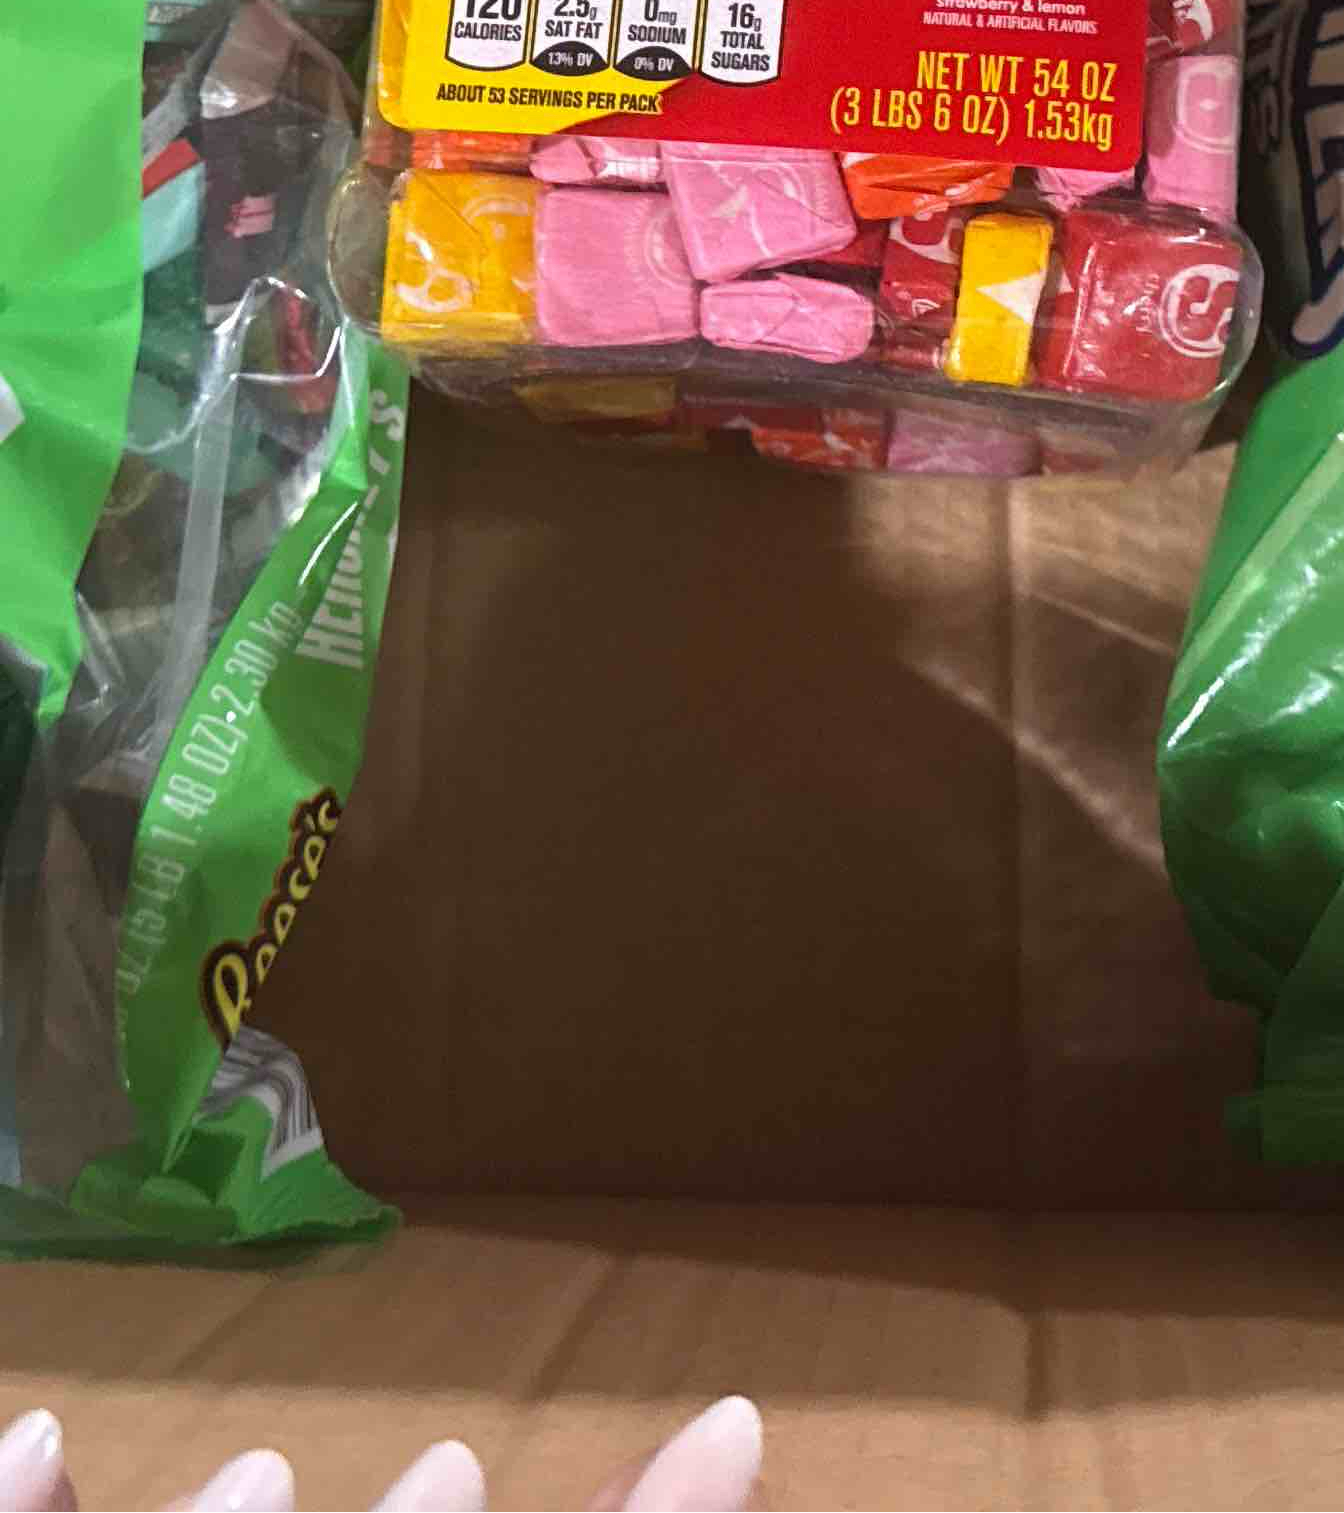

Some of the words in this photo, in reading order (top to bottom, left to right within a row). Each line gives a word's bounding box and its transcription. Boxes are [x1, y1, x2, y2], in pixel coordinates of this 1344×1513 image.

[1022, 0, 1035, 13] &
[1037, 0, 1086, 15] lemon
[454, 21, 523, 42] CALORIES
[544, 19, 573, 38] SAT
[575, 21, 604, 40] FAT
[922, 11, 973, 28] NATURAL
[987, 15, 1044, 31] ARTIFICIAL
[1048, 19, 1099, 35] FLAVORS
[627, 24, 687, 46] SODIUM
[719, 30, 765, 51] TOTAL
[576, 53, 594, 67] DV
[657, 57, 675, 72] DV
[710, 52, 771, 72] SUGARS
[917, 50, 975, 91] NET
[980, 54, 1025, 95] WT
[1033, 58, 1071, 98] 54
[1082, 62, 1117, 102] OZ
[435, 82, 487, 103] ABOUT
[487, 85, 506, 104] 53
[509, 87, 584, 110] SERVINGS
[586, 91, 616, 111] PER
[619, 92, 659, 114] PACK
[829, 86, 860, 136] (3
[871, 89, 923, 130] LBS
[933, 91, 952, 131] 6
[962, 93, 1011, 145] OZ)
[1024, 99, 1113, 151] 1.53kg
